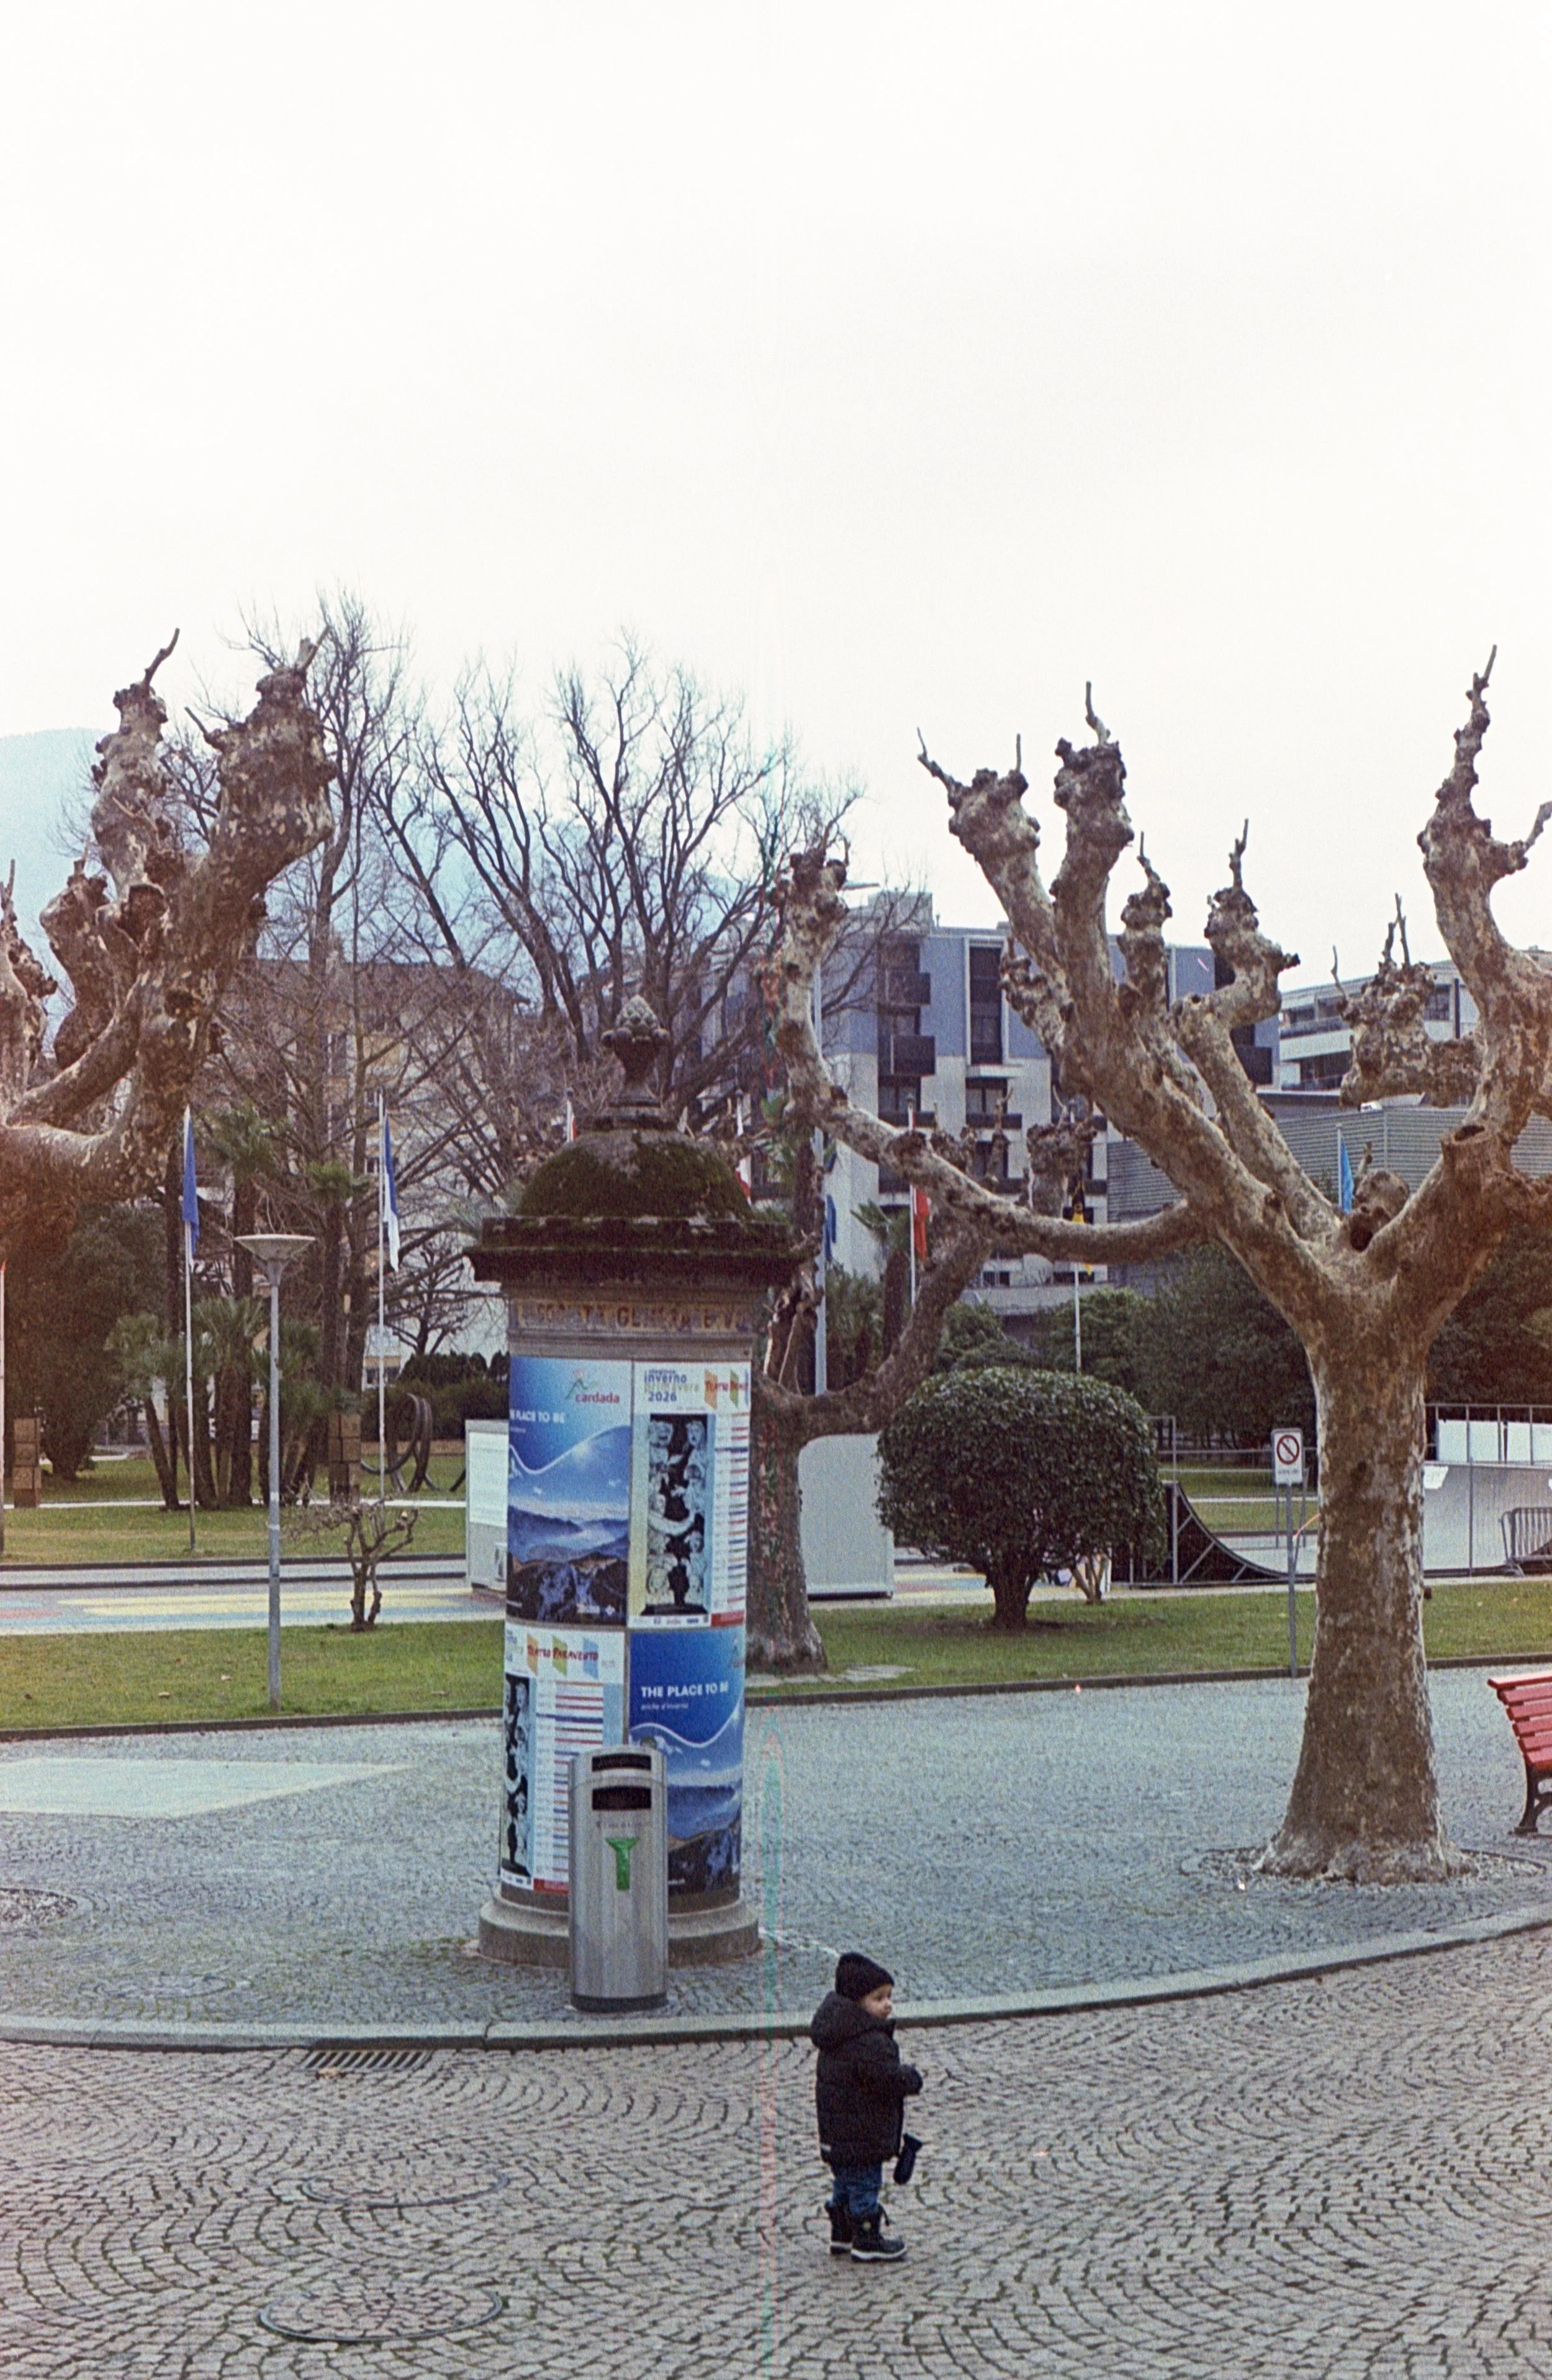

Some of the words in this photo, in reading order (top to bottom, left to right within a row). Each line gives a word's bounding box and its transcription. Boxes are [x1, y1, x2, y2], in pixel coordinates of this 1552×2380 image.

[644, 1370, 687, 1383] inverno
[575, 1392, 620, 1404] cardada
[648, 1391, 677, 1402] 2026
[538, 1411, 551, 1423] TO
[641, 1686, 664, 1698] THE
[667, 1683, 703, 1697] PLACE
[705, 1682, 718, 1695] TO
